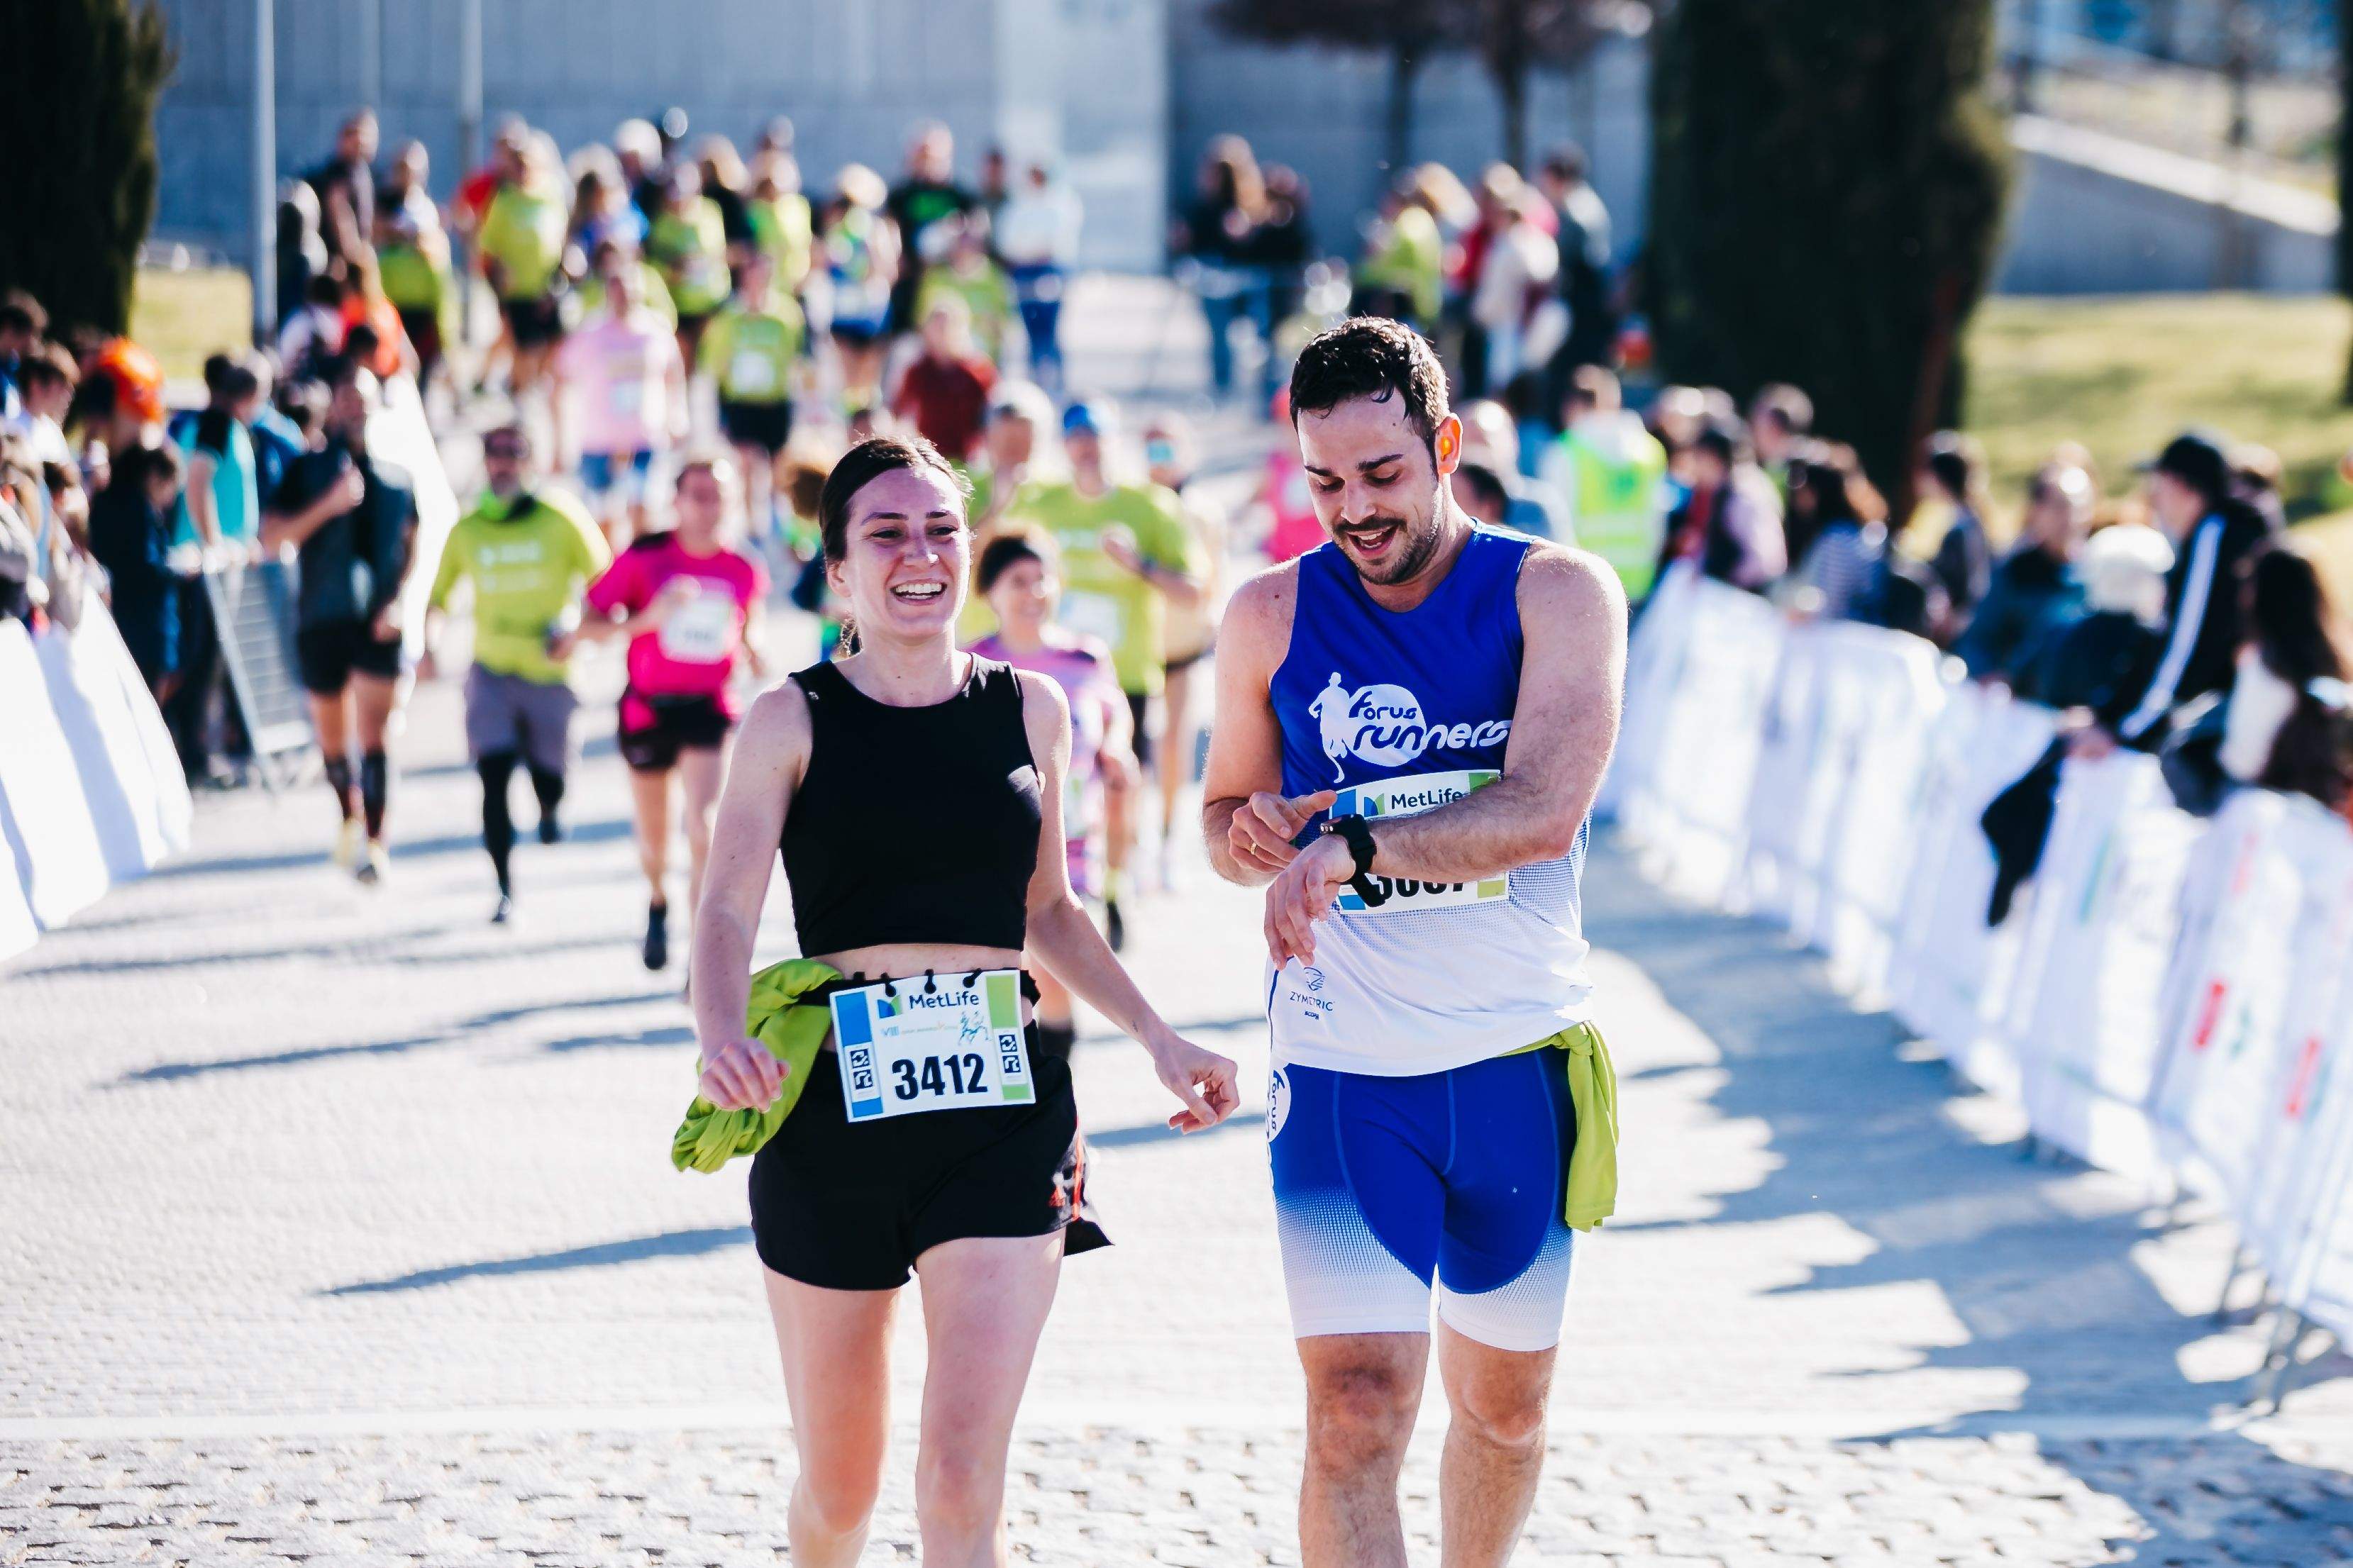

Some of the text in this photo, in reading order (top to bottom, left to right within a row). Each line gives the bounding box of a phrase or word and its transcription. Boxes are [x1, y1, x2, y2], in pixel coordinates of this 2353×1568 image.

[1353, 721, 1513, 750] runners
[1391, 788, 1463, 809] MetLife
[909, 991, 980, 1009] MetLife
[1290, 991, 1334, 1011] ZYMETRIC
[892, 1053, 988, 1100] 3412
